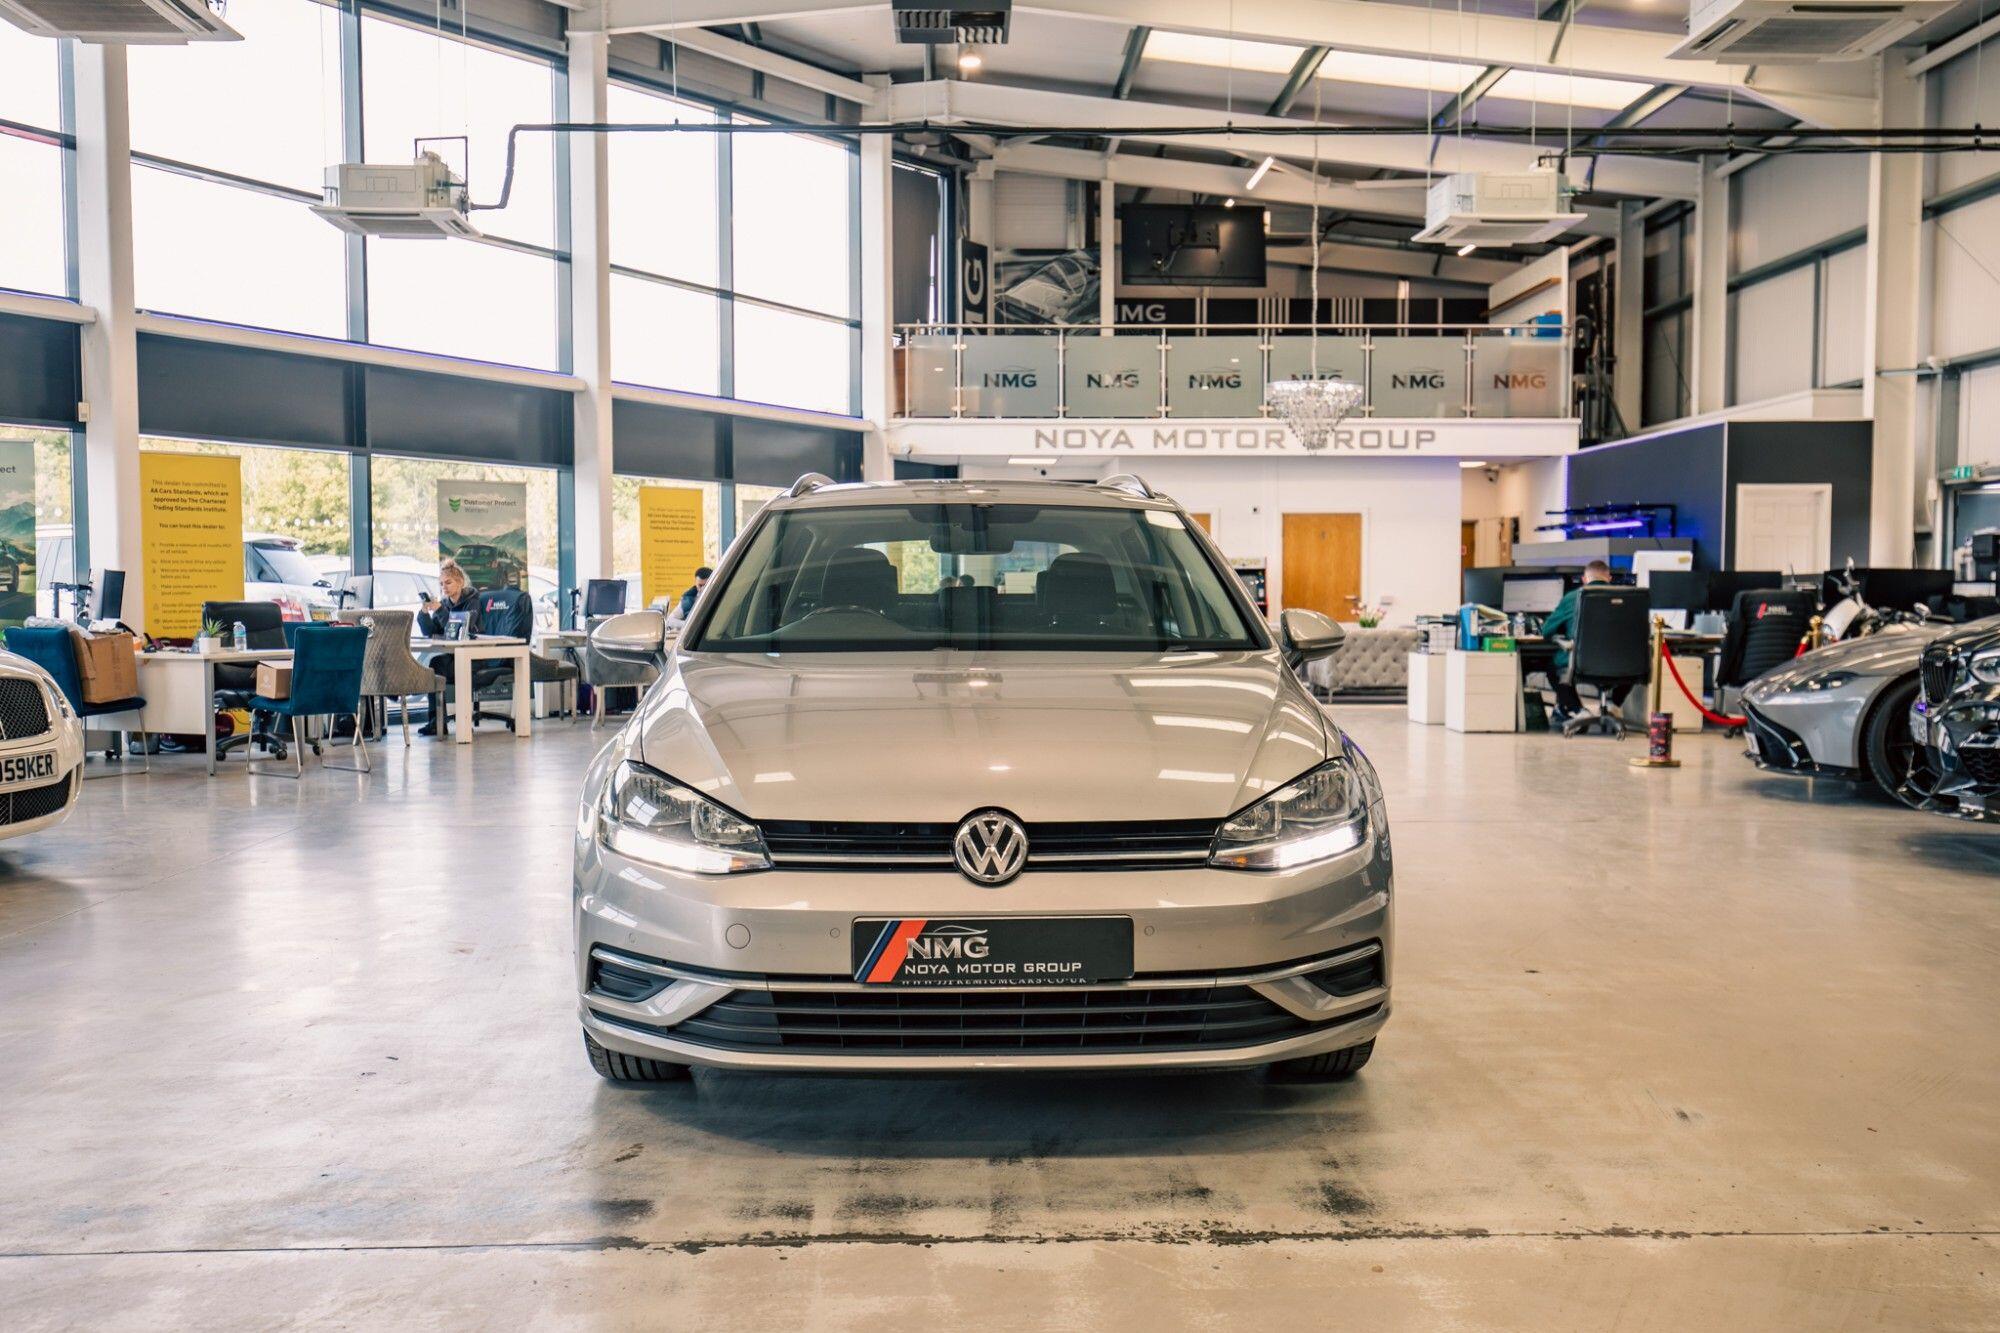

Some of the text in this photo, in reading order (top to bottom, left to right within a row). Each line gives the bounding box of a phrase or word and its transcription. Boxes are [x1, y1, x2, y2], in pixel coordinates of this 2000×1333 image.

[984, 373, 1037, 388] NMG
[1189, 374, 1242, 389] NMG
[1392, 374, 1445, 389] NMG
[1493, 374, 1546, 389] NMG
[1034, 429, 1436, 449] NOYA MOTOR ROUP
[0, 753, 54, 783] 59KER
[905, 936, 989, 960] NMG
[905, 962, 1082, 975] NOYA MOTOR GROUP
